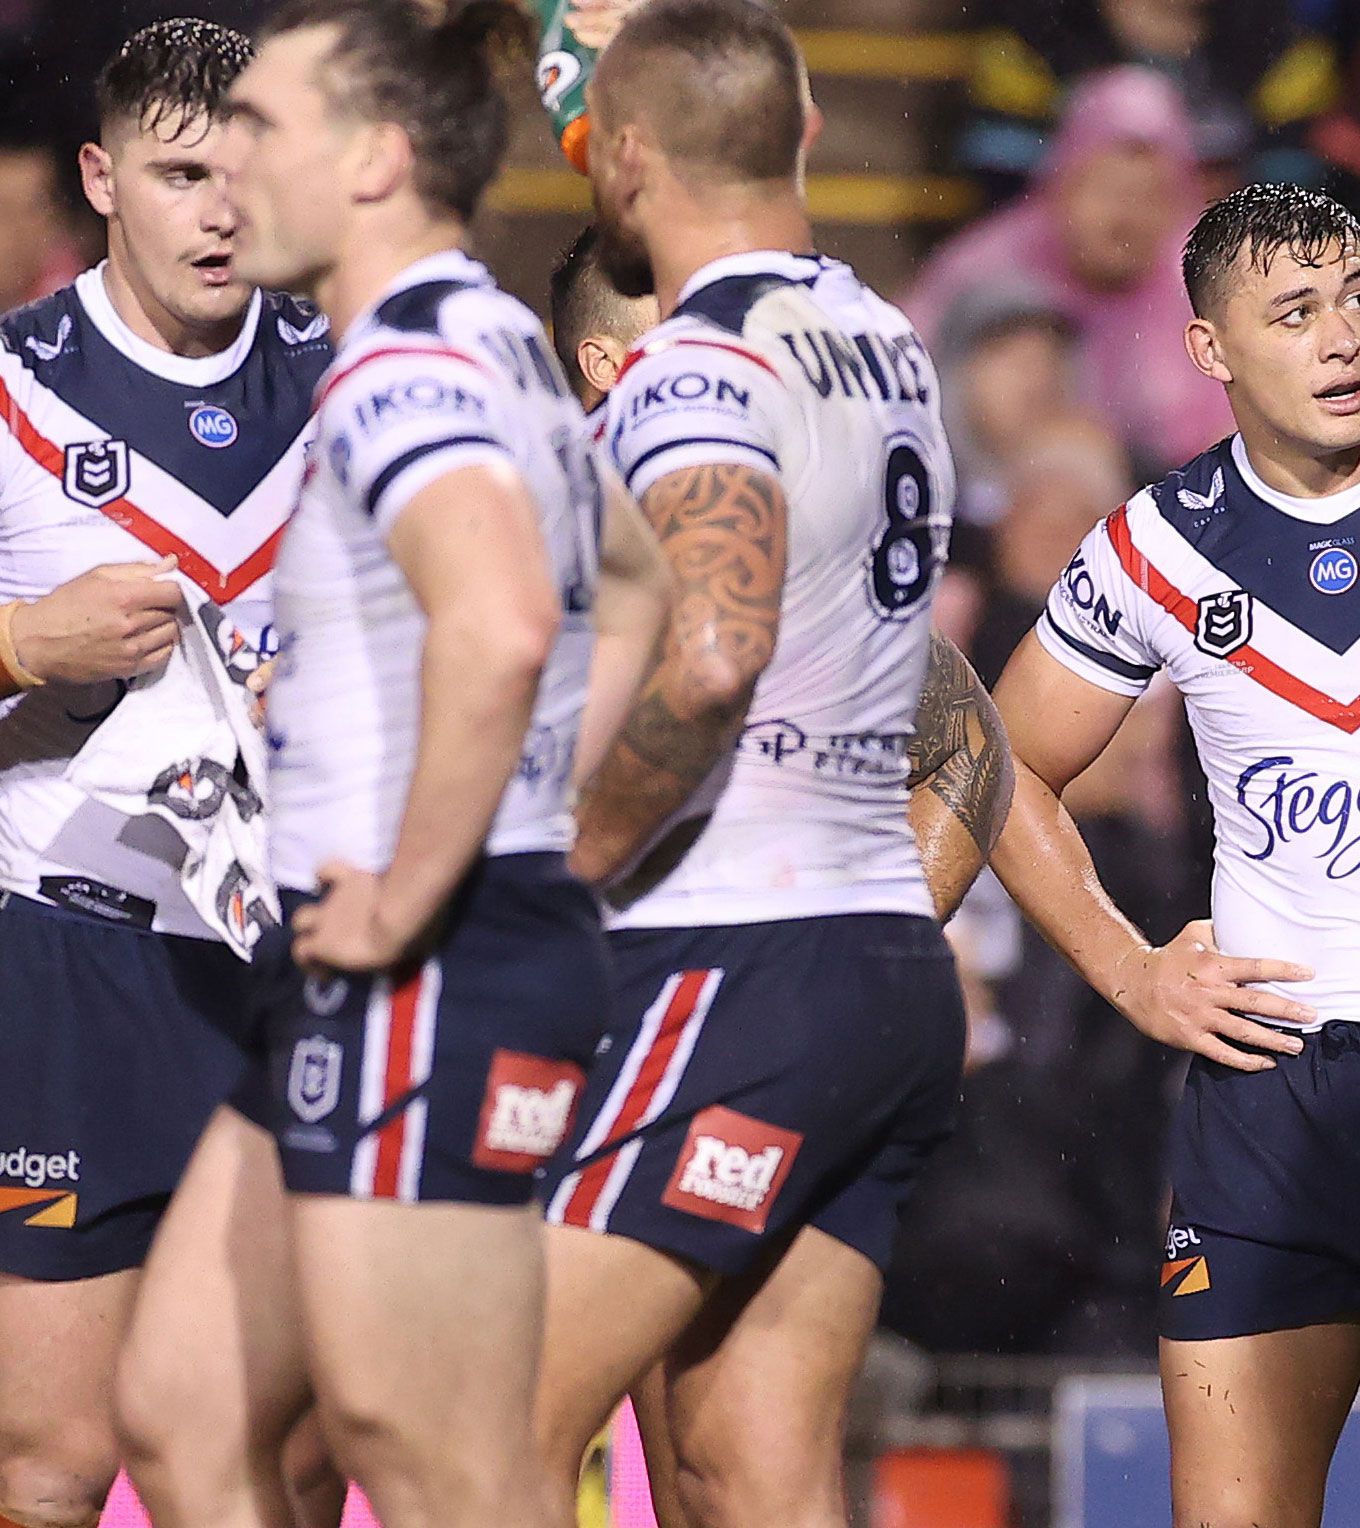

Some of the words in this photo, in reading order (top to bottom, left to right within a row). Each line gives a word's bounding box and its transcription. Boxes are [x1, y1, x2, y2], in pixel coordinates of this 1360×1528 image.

[629, 373, 750, 418] IKON
[197, 413, 233, 437] MG
[870, 434, 943, 616] 8
[1316, 558, 1352, 583] MG
[682, 1135, 784, 1194] red
